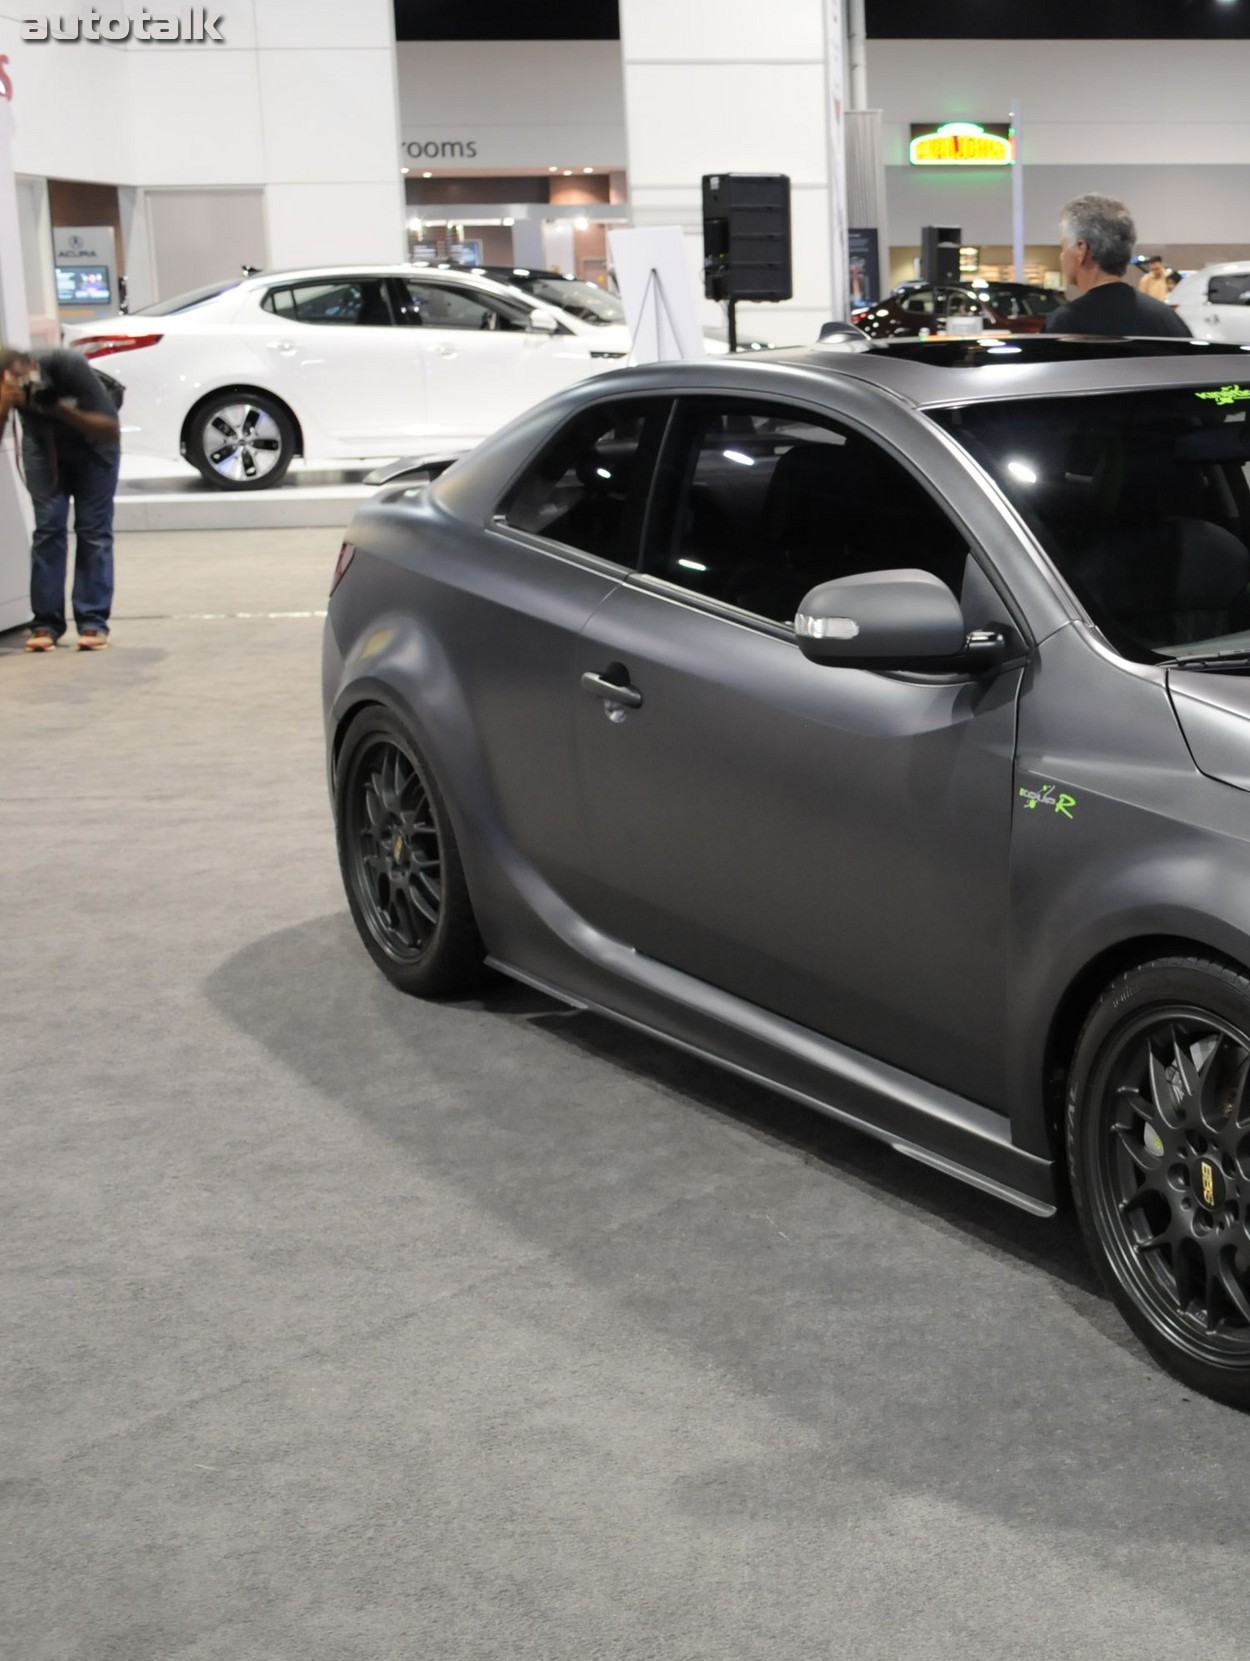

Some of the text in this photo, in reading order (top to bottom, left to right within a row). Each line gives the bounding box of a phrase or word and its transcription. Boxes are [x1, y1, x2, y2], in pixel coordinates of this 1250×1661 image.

[401, 140, 477, 158] ooms
[58, 250, 98, 258] ACURA
[1201, 1161, 1215, 1206] BBS
